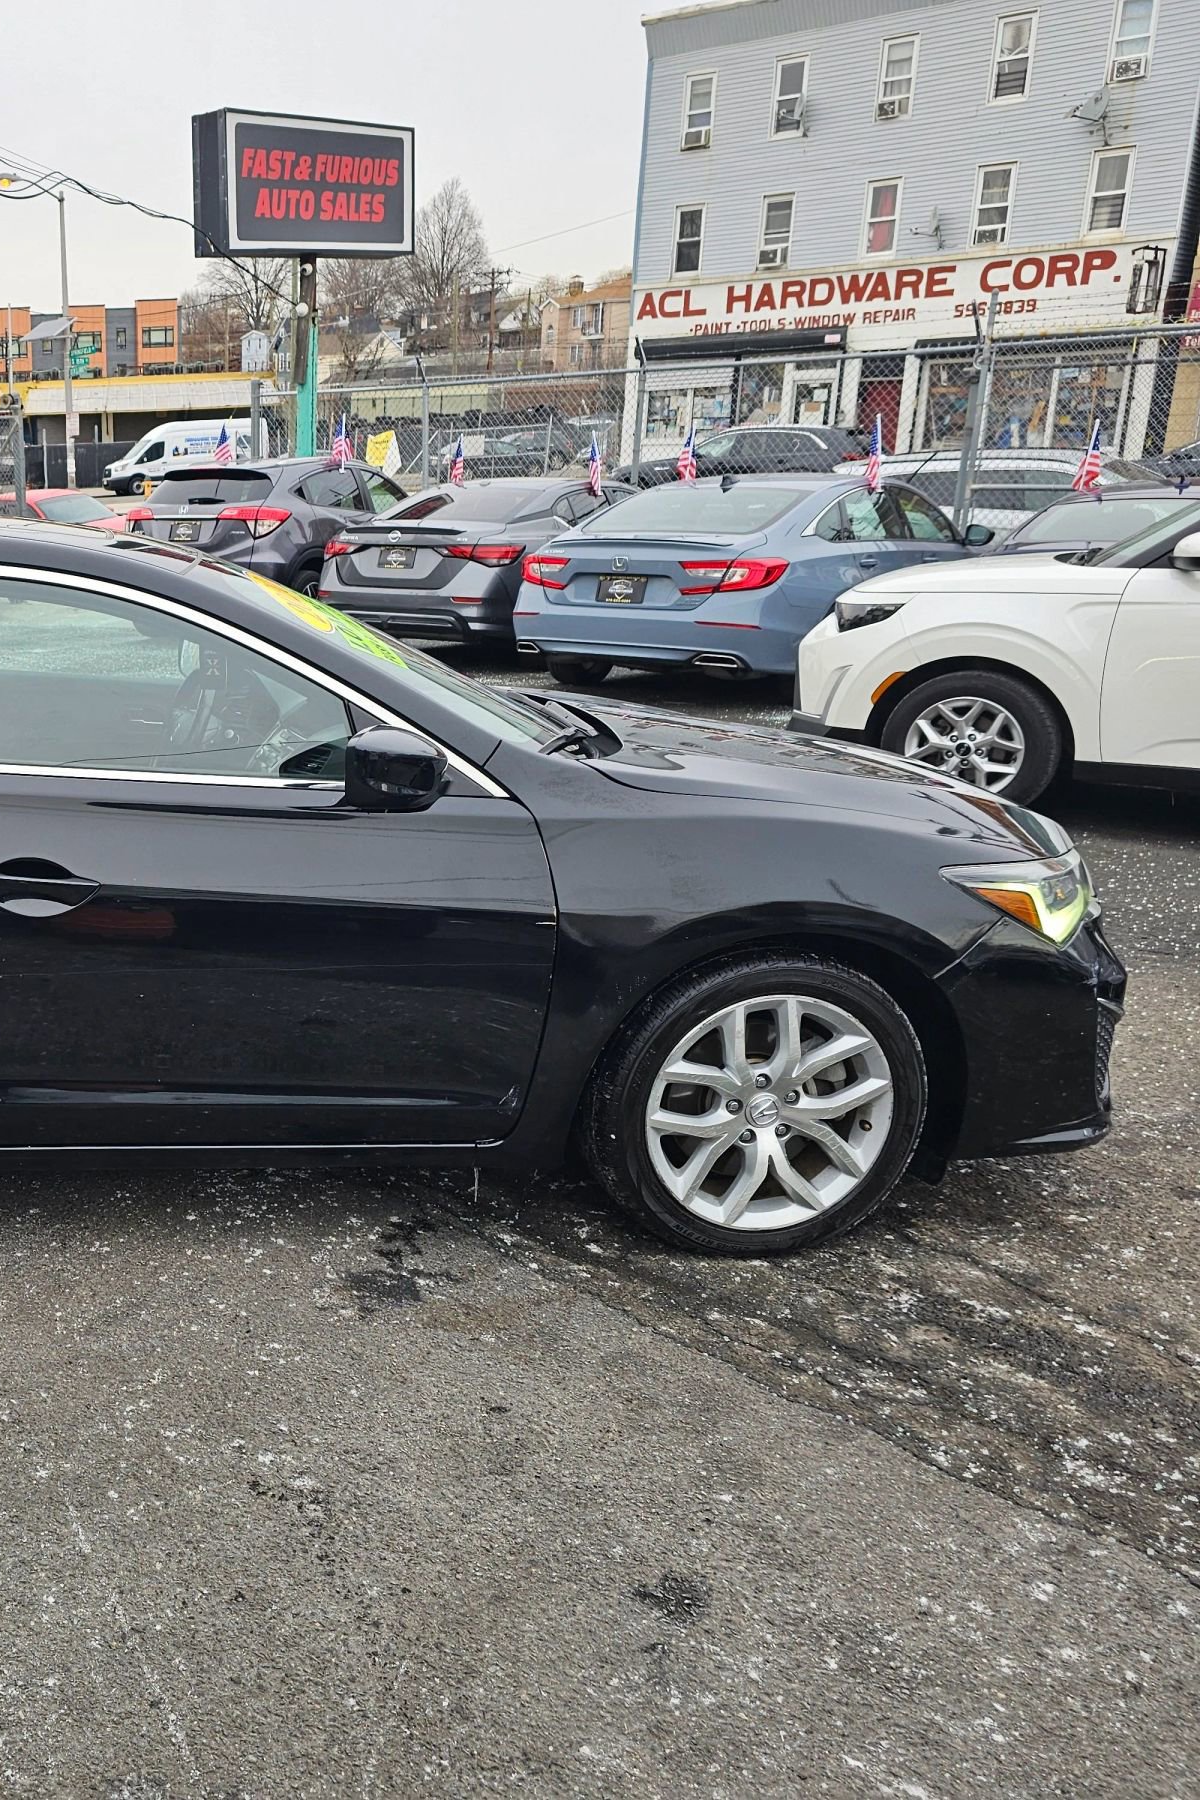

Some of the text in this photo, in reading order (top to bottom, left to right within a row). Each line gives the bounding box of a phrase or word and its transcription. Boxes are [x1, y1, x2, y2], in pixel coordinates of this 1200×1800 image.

[241, 148, 399, 186] FAST & FURIOUS
[255, 188, 385, 223] AUTO SALES
[637, 250, 1121, 320] ACL HARDWARE CORP.
[794, 313, 856, 329] WINDOW
[863, 308, 916, 324] REPAIR
